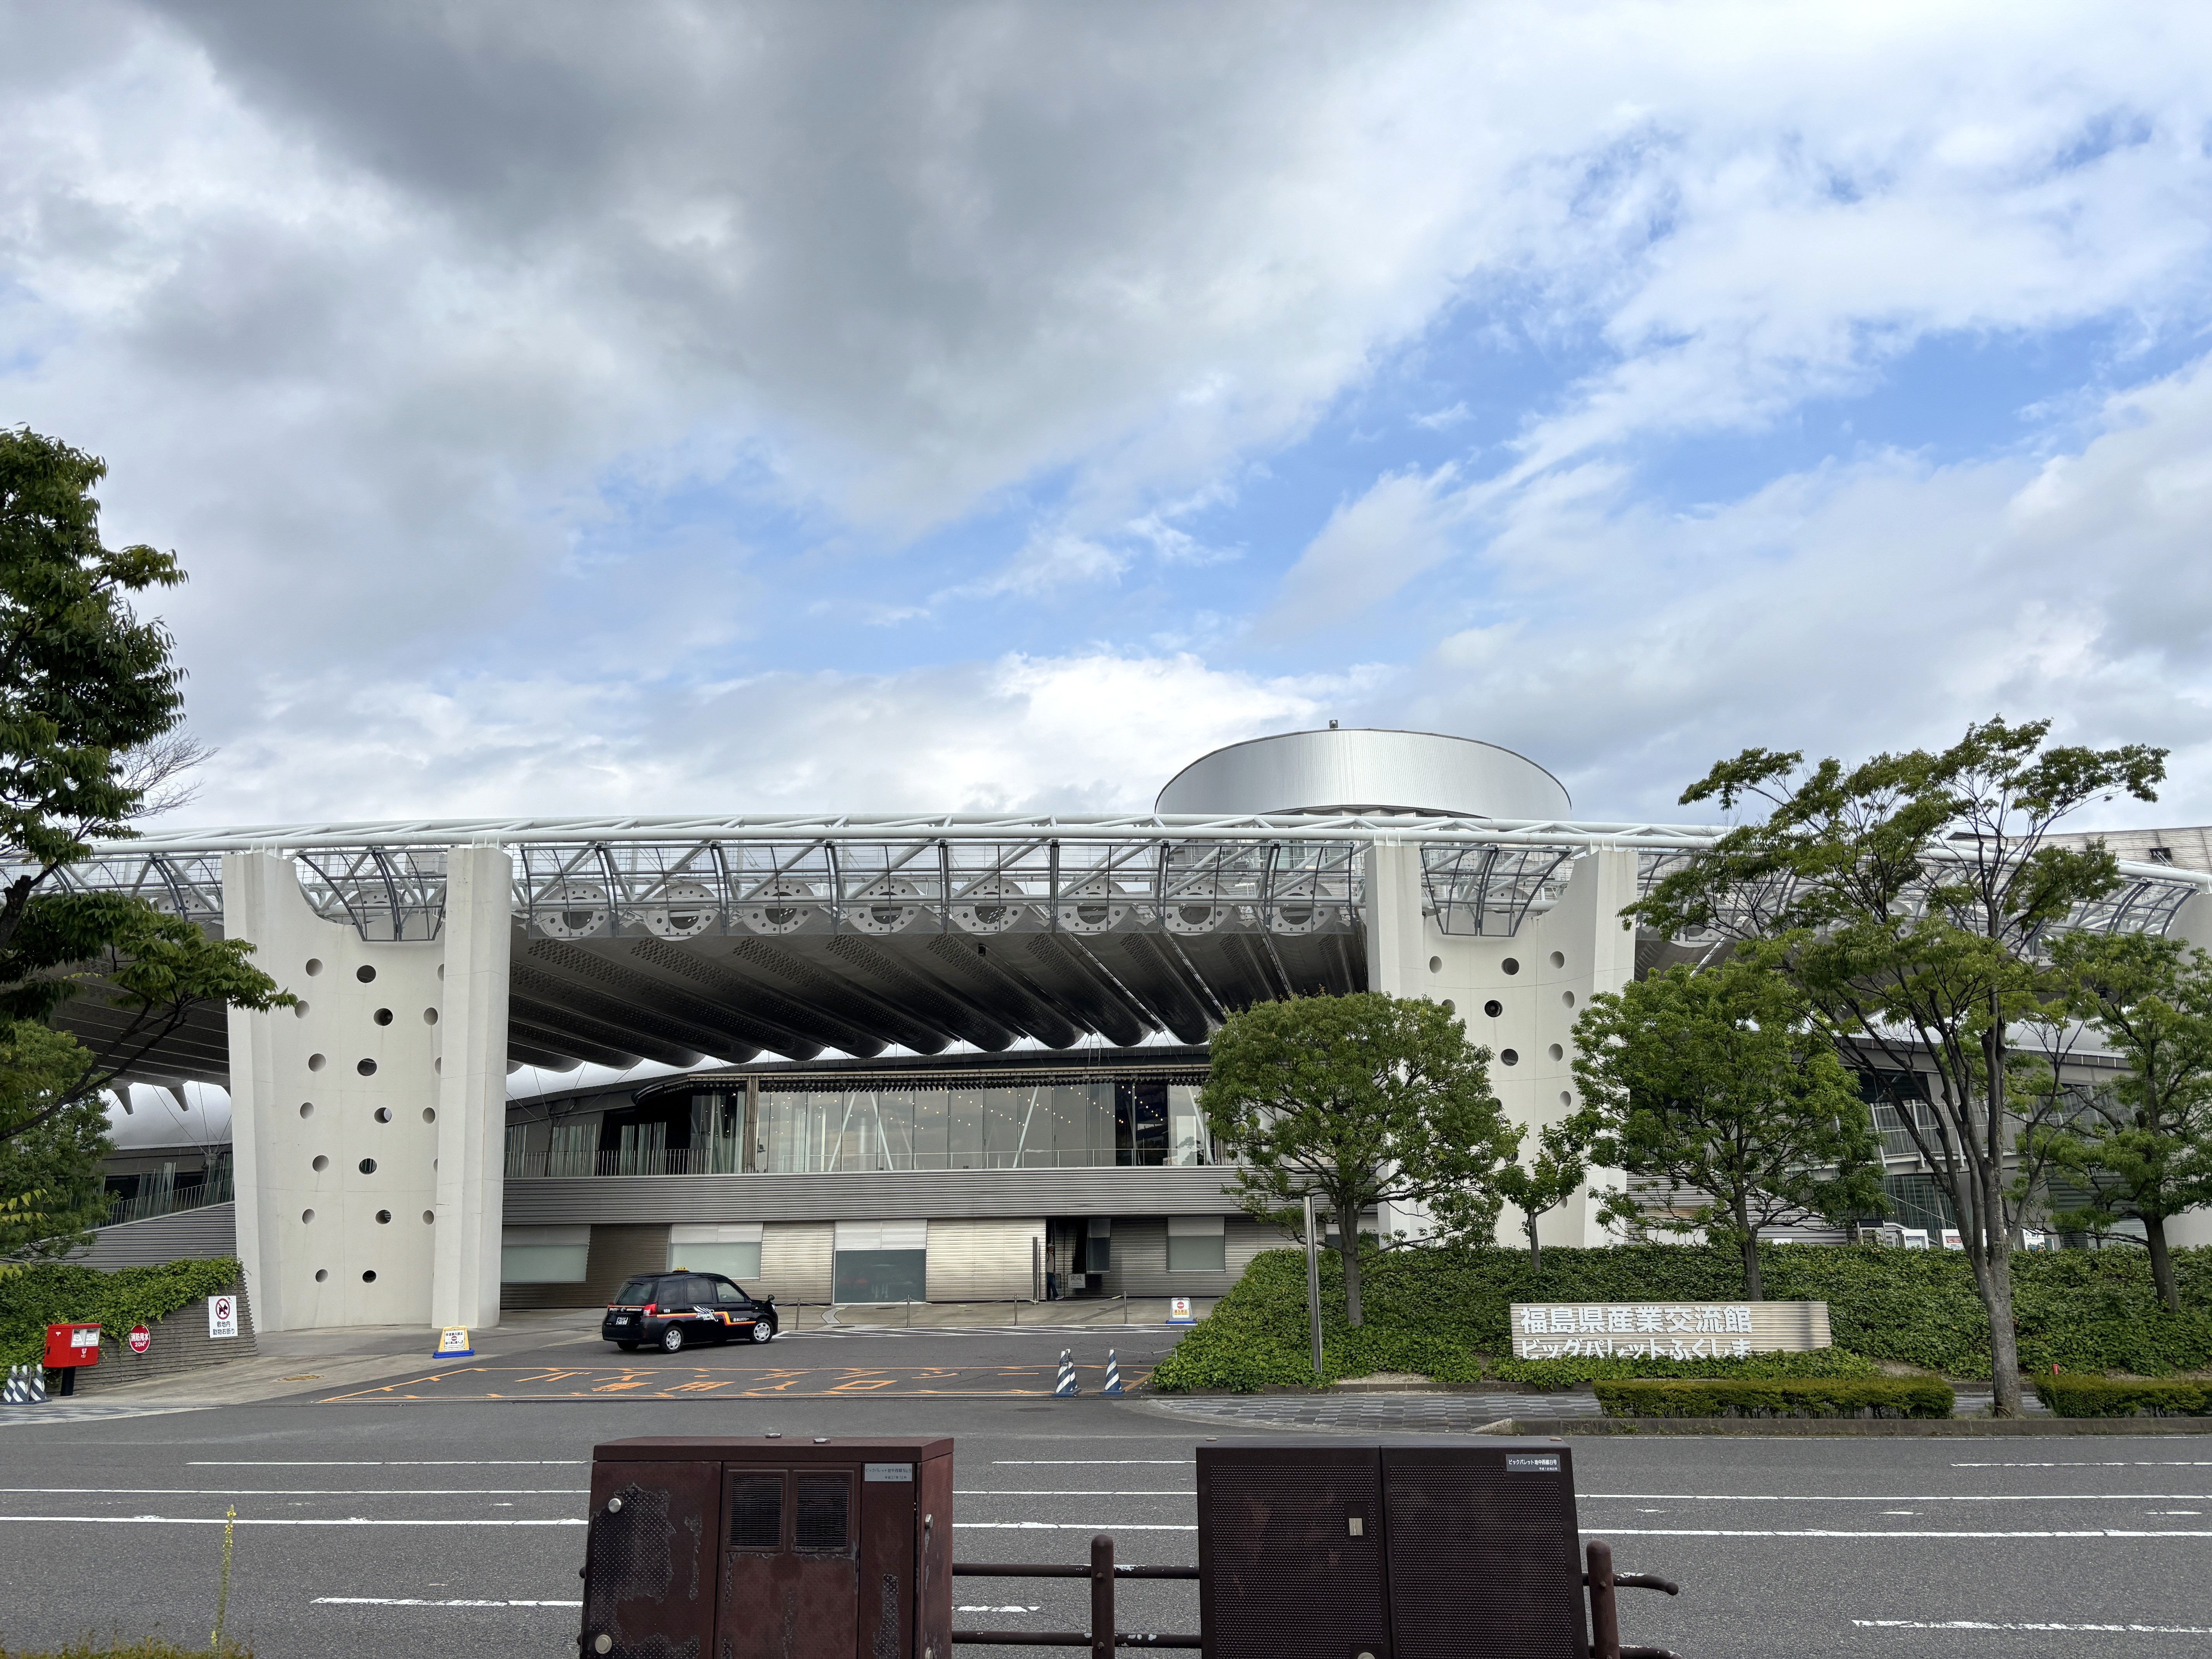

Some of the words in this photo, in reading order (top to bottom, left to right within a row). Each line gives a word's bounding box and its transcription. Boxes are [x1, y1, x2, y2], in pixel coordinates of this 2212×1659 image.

[1520, 1305, 1752, 1334] 福島県産業交流館
[131, 1332, 149, 1342] 消防用水
[1522, 1338, 1751, 1360] ビッグパレットふくしま
[591, 1380, 898, 1392] 専用入口
